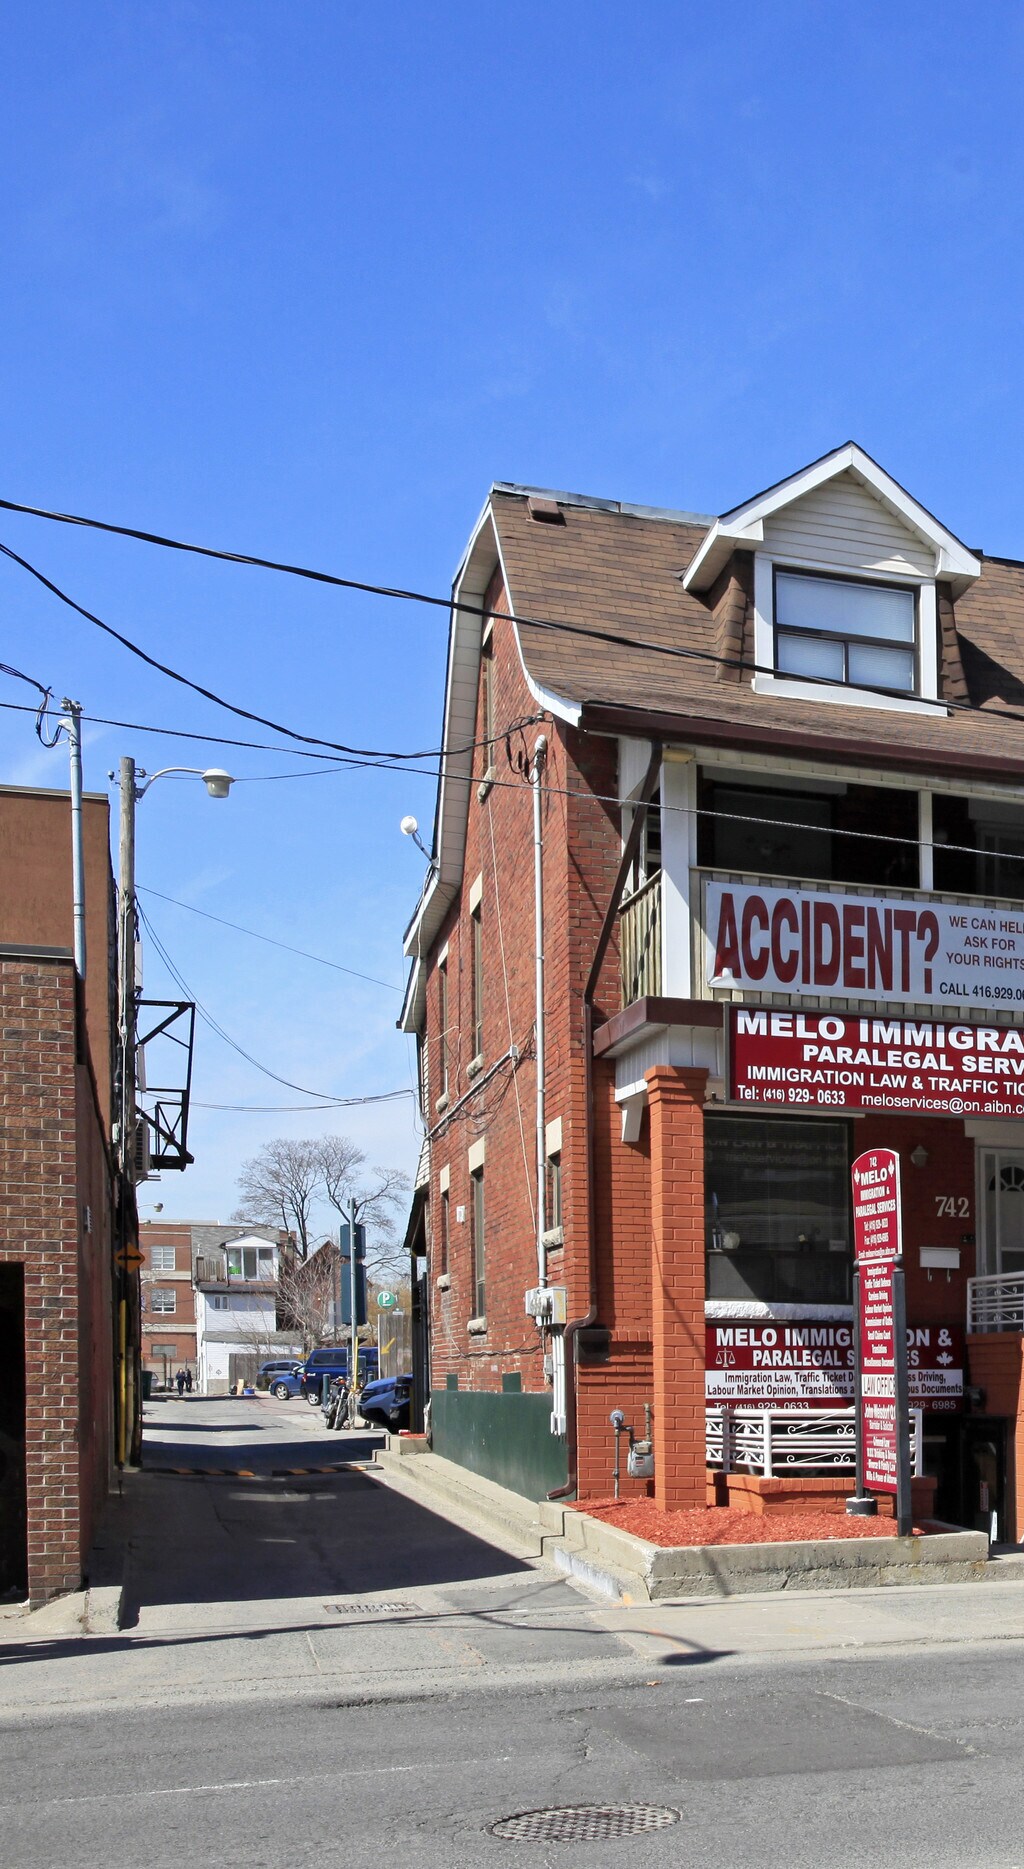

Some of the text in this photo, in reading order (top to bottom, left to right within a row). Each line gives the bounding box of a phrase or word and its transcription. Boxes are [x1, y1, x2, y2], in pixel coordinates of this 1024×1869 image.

[949, 915, 969, 930] WE
[971, 916, 996, 932] CAN
[713, 892, 940, 995] ACCIDENT?
[964, 935, 1016, 951] ASK FOR
[946, 952, 980, 967] YOUR
[939, 981, 969, 997] CALL
[736, 1010, 846, 1041] MELO
[803, 1044, 953, 1072] PARALEGAL
[747, 1065, 865, 1086] IMMIGRATION
[870, 1073, 907, 1088] LAW
[912, 1075, 923, 1089] &
[928, 1077, 998, 1095] TRAFFIC
[738, 1085, 846, 1105] Tel: (416) 929- 0633
[861, 1168, 887, 1186] MELO
[935, 1196, 970, 1217] 742
[716, 1328, 777, 1346] MELO
[937, 1328, 952, 1346] &
[752, 1349, 842, 1367] PARALEGAL
[724, 1372, 773, 1384] Immigration
[774, 1372, 793, 1385] Law,
[795, 1371, 820, 1382] Traffic
[822, 1371, 847, 1382] Ticket
[917, 1371, 946, 1384] Driving,
[707, 1384, 735, 1395] Labour
[737, 1384, 764, 1395] Market
[766, 1384, 799, 1397] Opinion,
[800, 1384, 849, 1395] Translations
[921, 1384, 963, 1395] Documents
[932, 1400, 957, 1410] 6985
